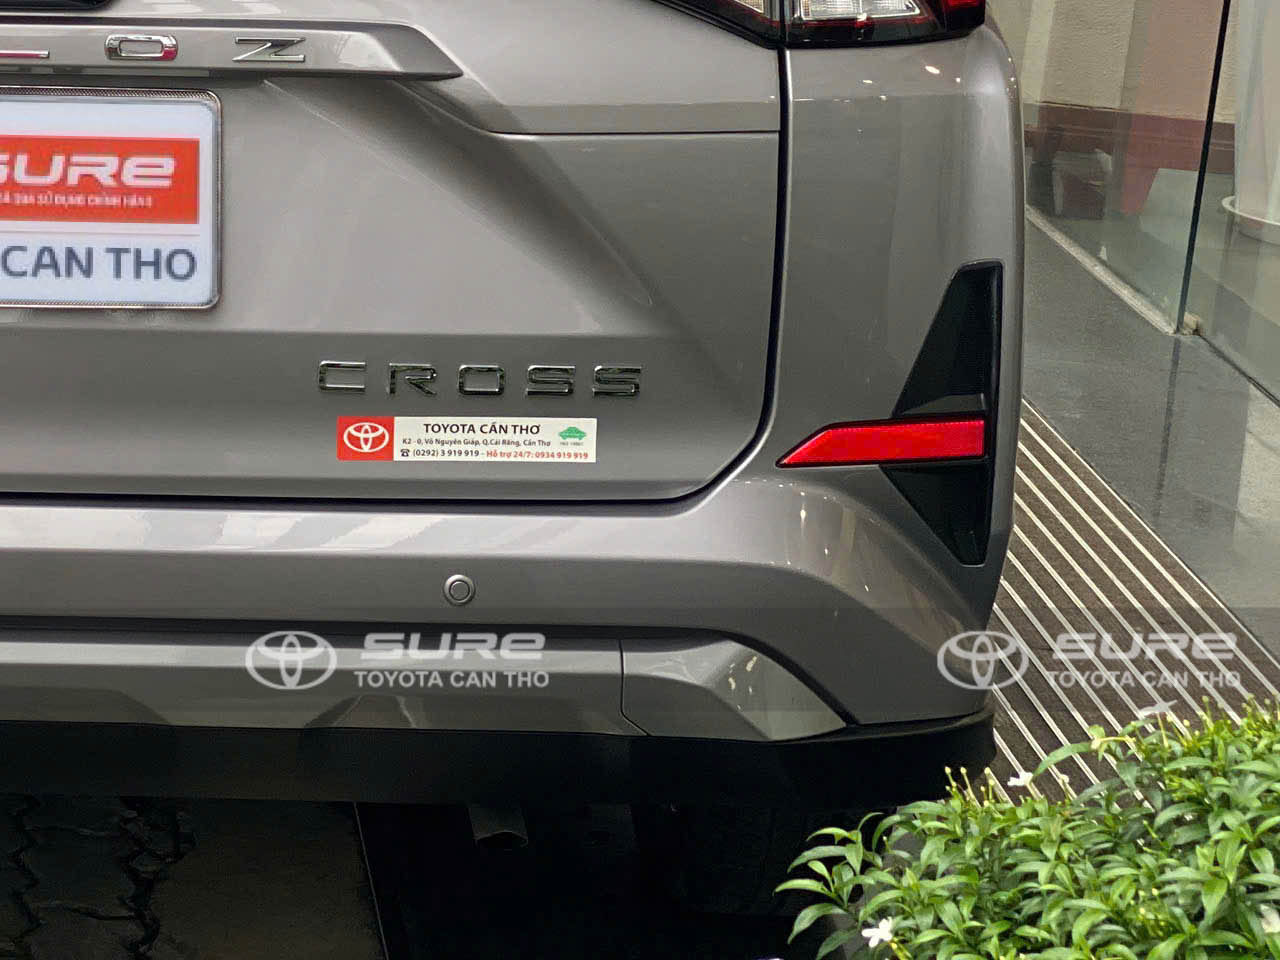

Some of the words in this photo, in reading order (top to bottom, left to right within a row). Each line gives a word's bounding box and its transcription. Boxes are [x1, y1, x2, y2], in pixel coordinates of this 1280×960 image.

[0, 245, 94, 279] CAN
[104, 247, 198, 282] THO
[319, 360, 642, 397] CROSS
[424, 423, 476, 434] TOYOTA
[511, 424, 541, 435] THƠ
[413, 449, 439, 457] (0292)
[440, 449, 446, 457] 3
[447, 449, 462, 457] 919
